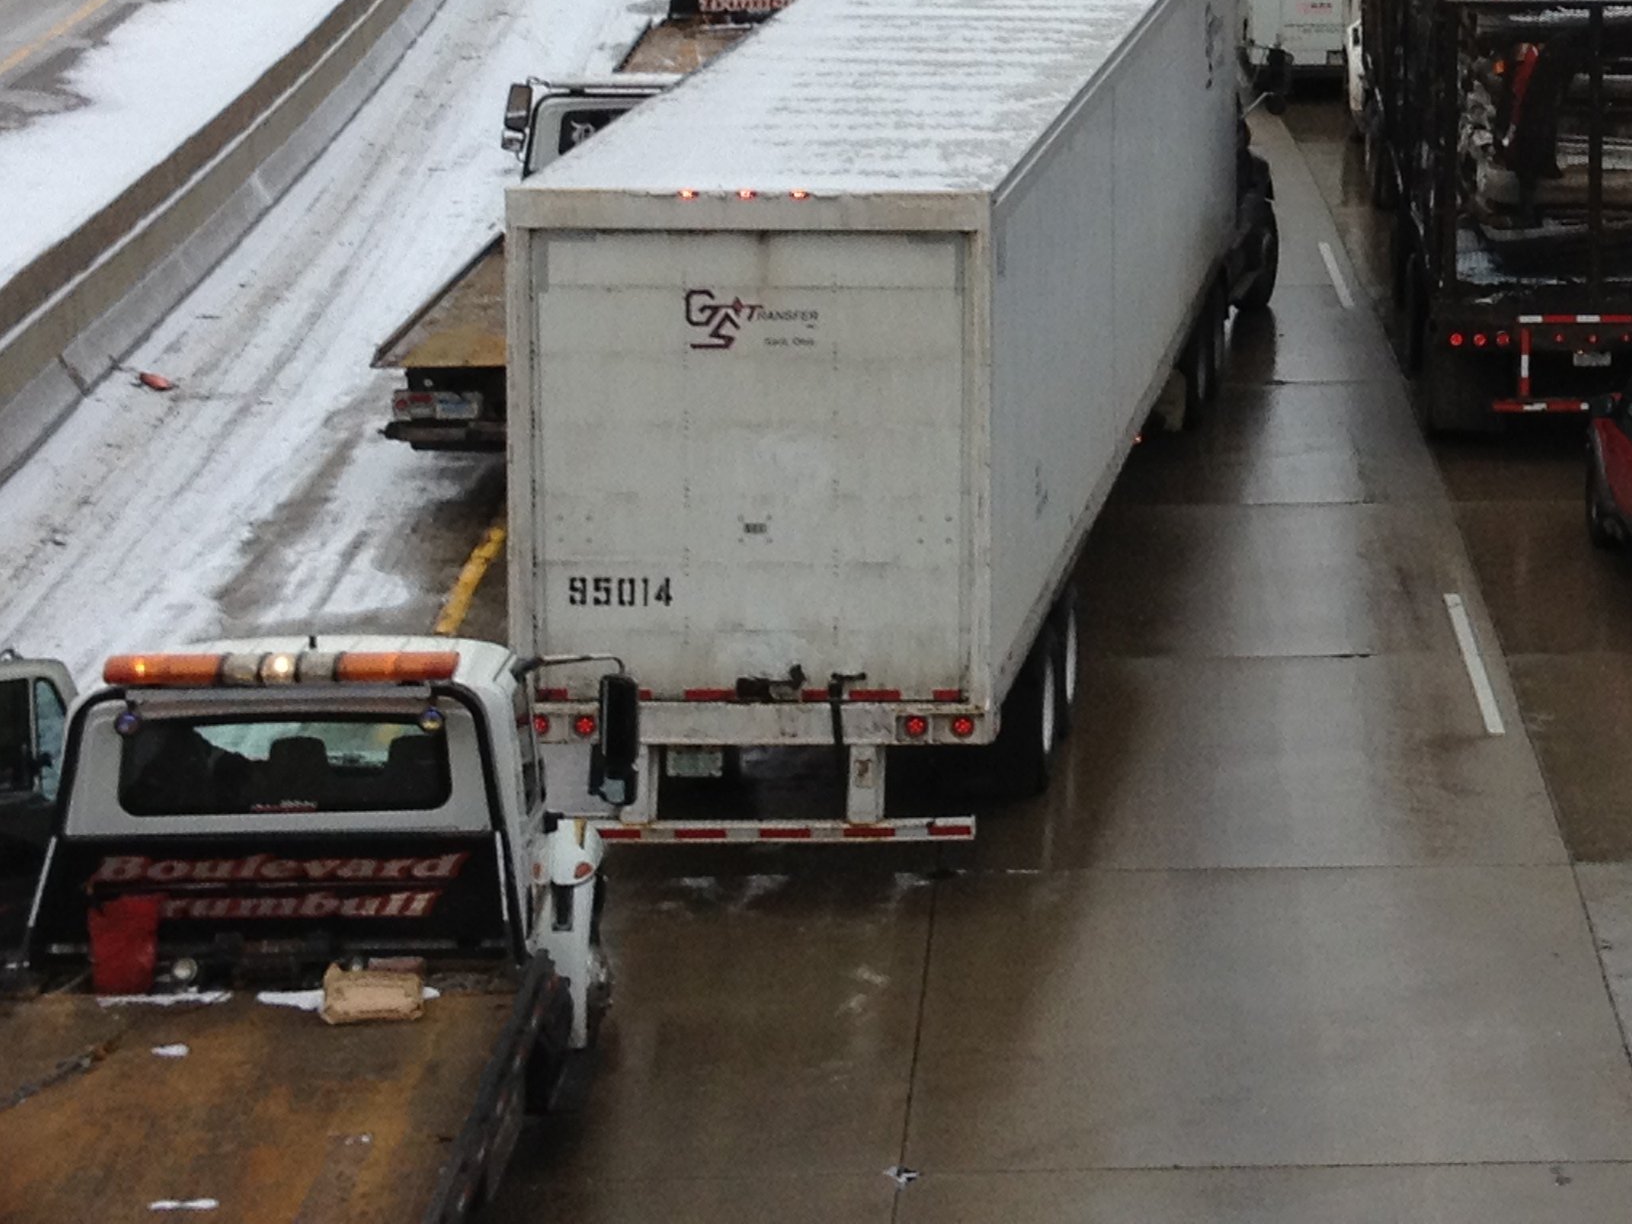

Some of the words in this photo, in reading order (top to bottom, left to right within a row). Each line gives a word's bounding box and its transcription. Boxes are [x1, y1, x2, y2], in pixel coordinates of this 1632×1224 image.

[568, 577, 673, 607] 95014
[98, 852, 470, 882] Boulevard
[158, 890, 443, 918] rumbull
